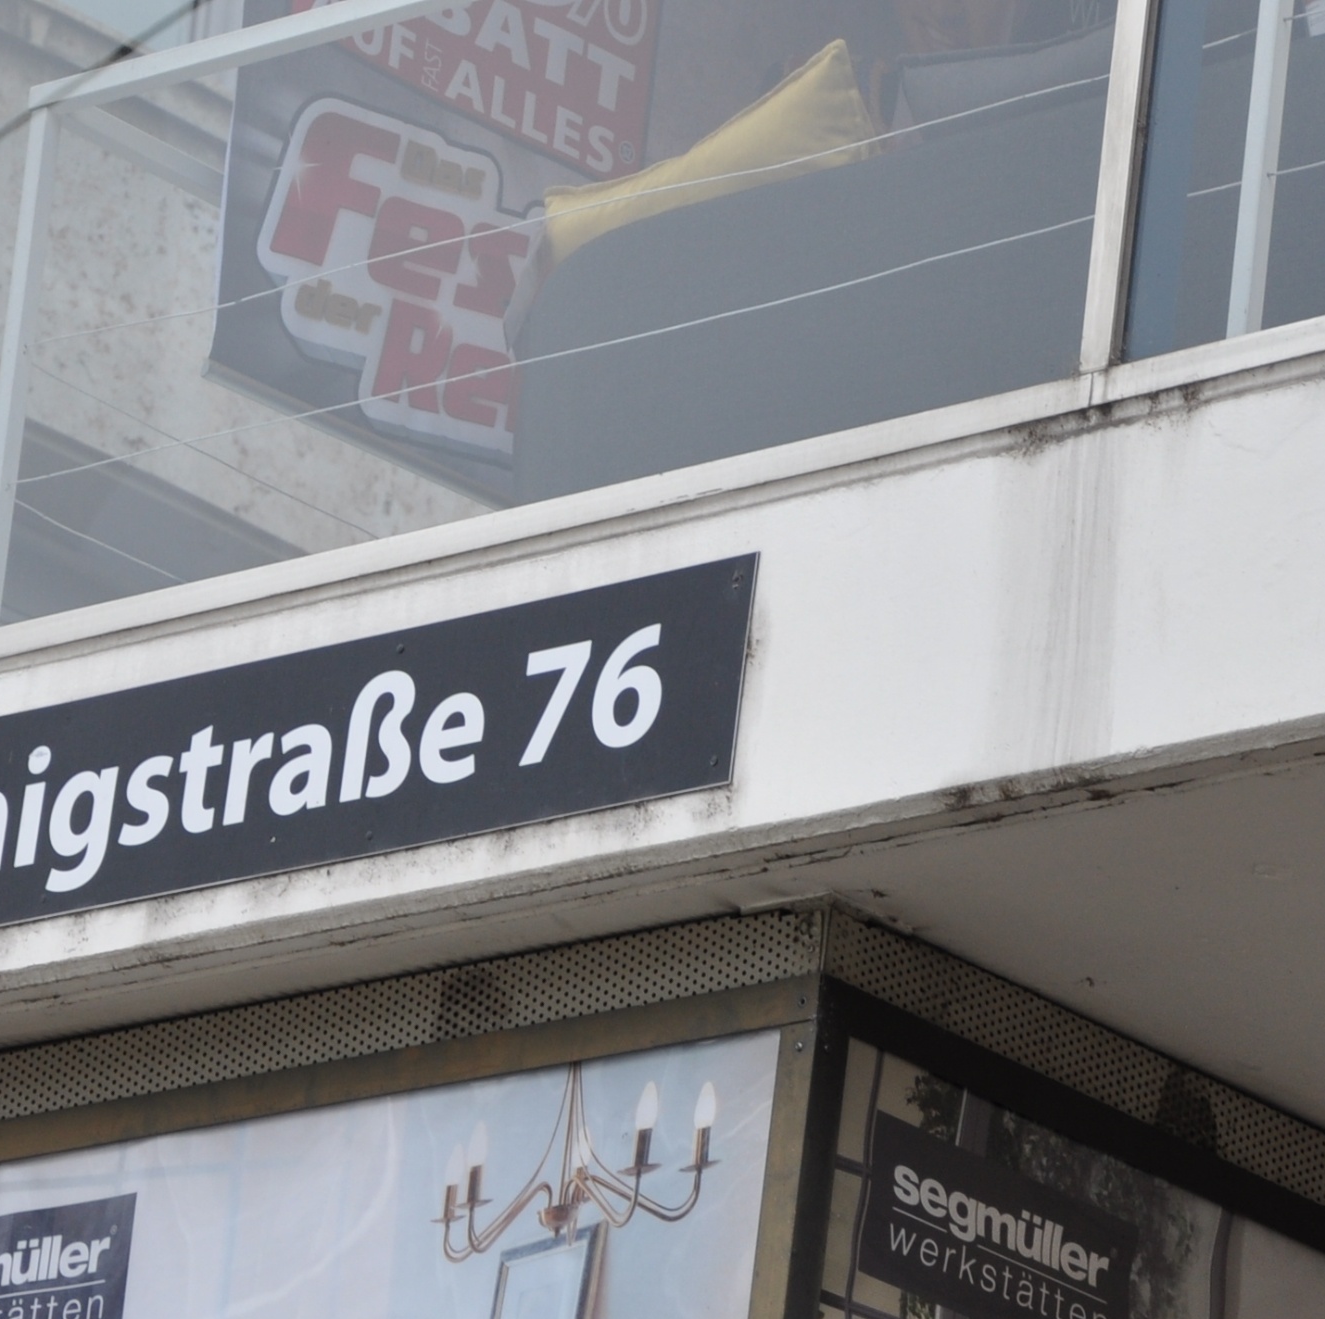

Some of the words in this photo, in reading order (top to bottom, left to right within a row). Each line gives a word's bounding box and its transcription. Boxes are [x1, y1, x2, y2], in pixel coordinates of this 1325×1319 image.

[353, 22, 417, 70] UF
[421, 38, 444, 92] FAST
[444, 58, 616, 174] ALLES
[269, 111, 531, 320] Fes
[401, 138, 486, 200] Das
[294, 278, 383, 336] der
[517, 623, 664, 767] 76
[892, 1164, 1110, 1288] segmüller
